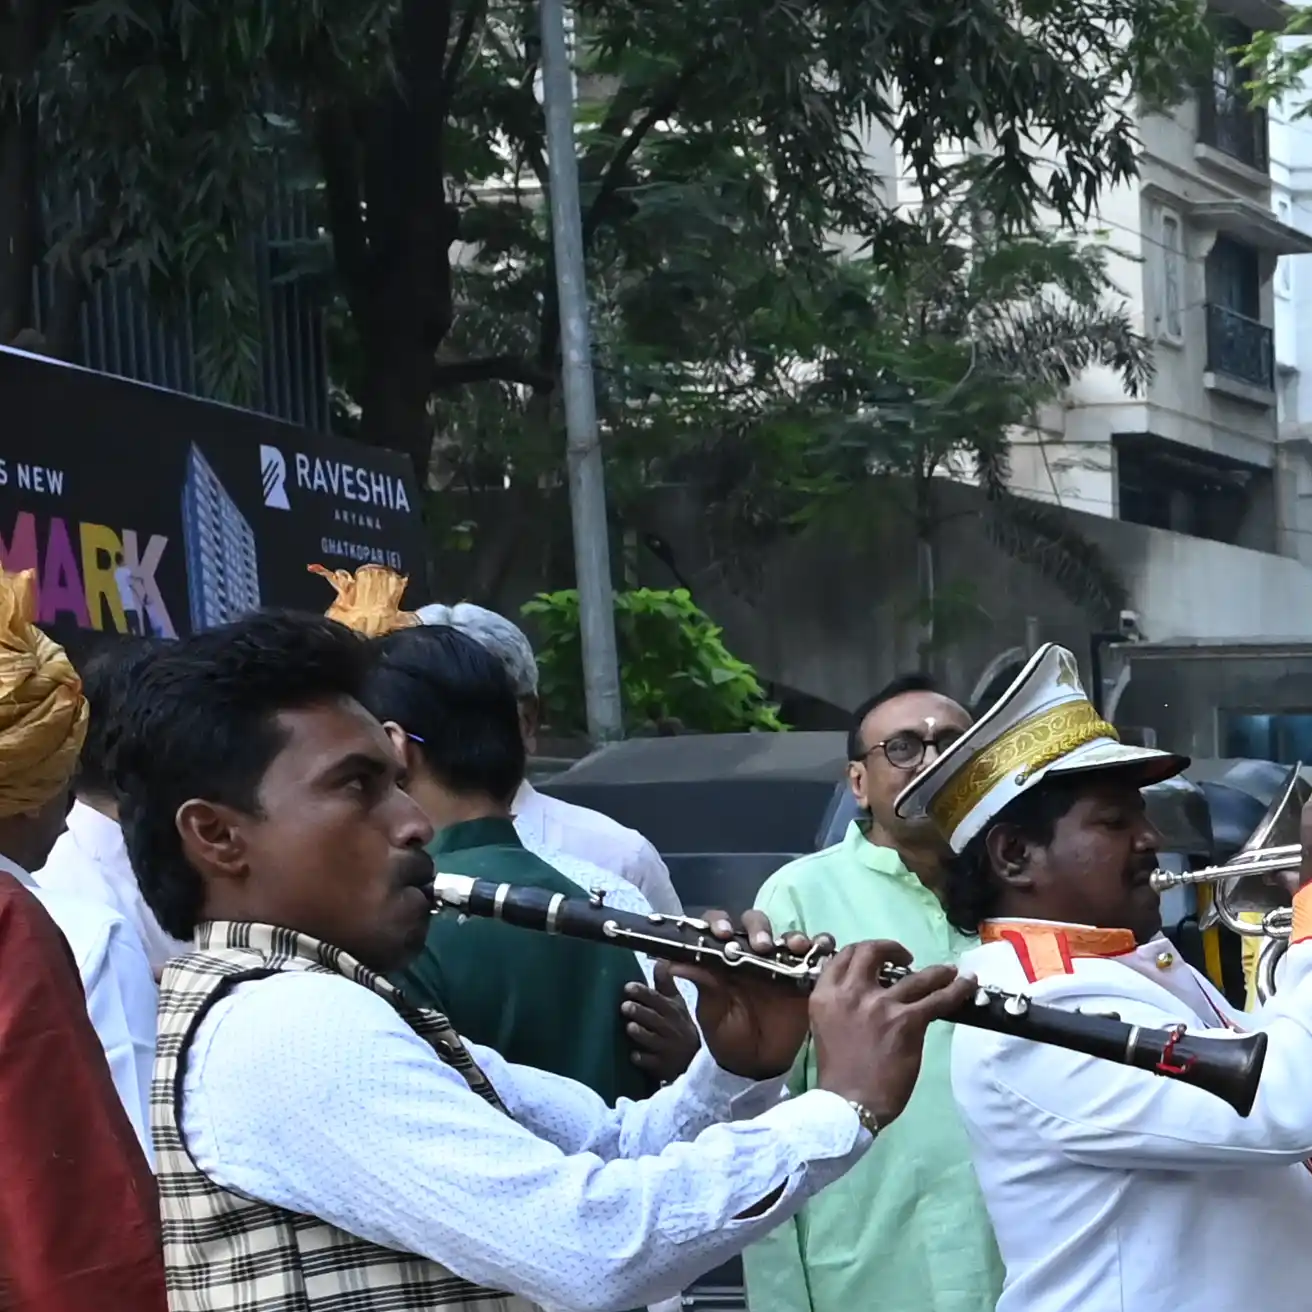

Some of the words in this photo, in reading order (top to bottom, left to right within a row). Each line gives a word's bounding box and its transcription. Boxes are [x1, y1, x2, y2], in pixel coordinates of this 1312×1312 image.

[17, 463, 64, 496] NEW
[296, 452, 411, 514] RAVESHIA
[334, 509, 382, 530] ARYANA
[321, 537, 384, 565] GHATKOPAR
